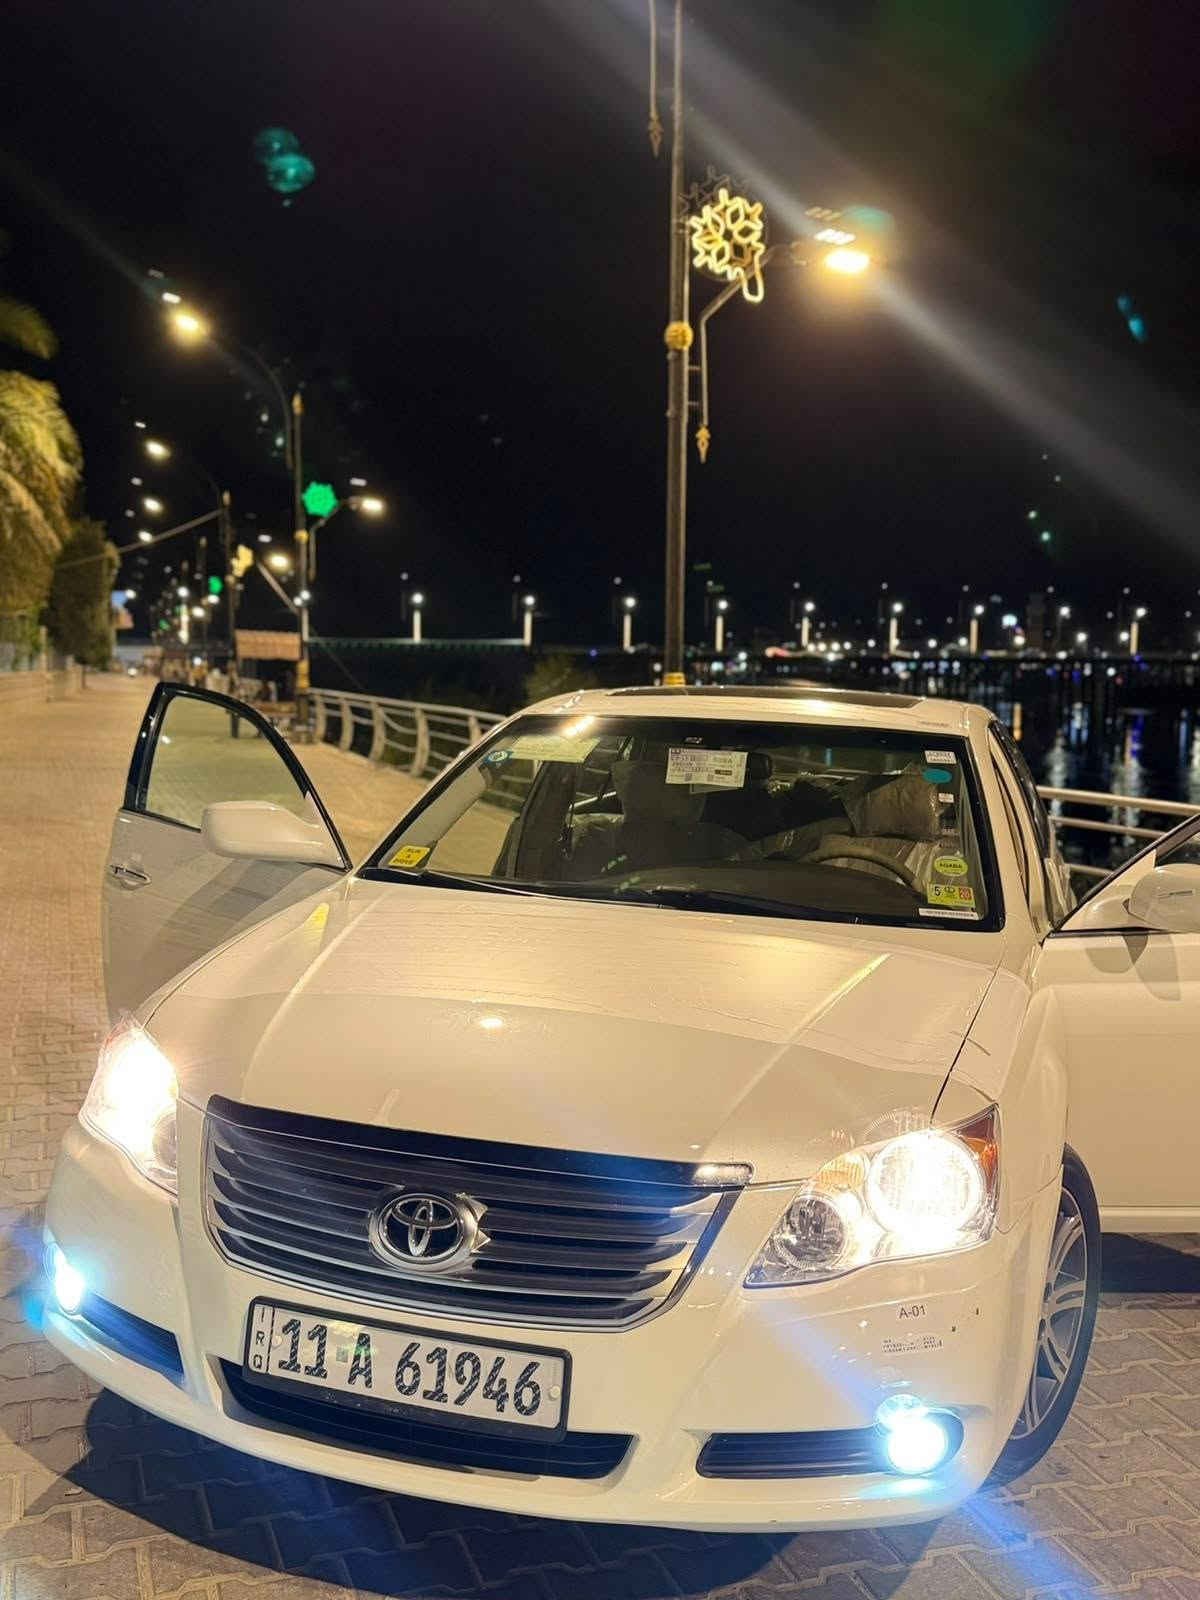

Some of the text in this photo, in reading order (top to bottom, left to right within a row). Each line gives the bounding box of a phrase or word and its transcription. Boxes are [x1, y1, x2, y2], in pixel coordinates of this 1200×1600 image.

[899, 1305, 926, 1319] A-01
[279, 1319, 541, 1416] 11 A 61946
